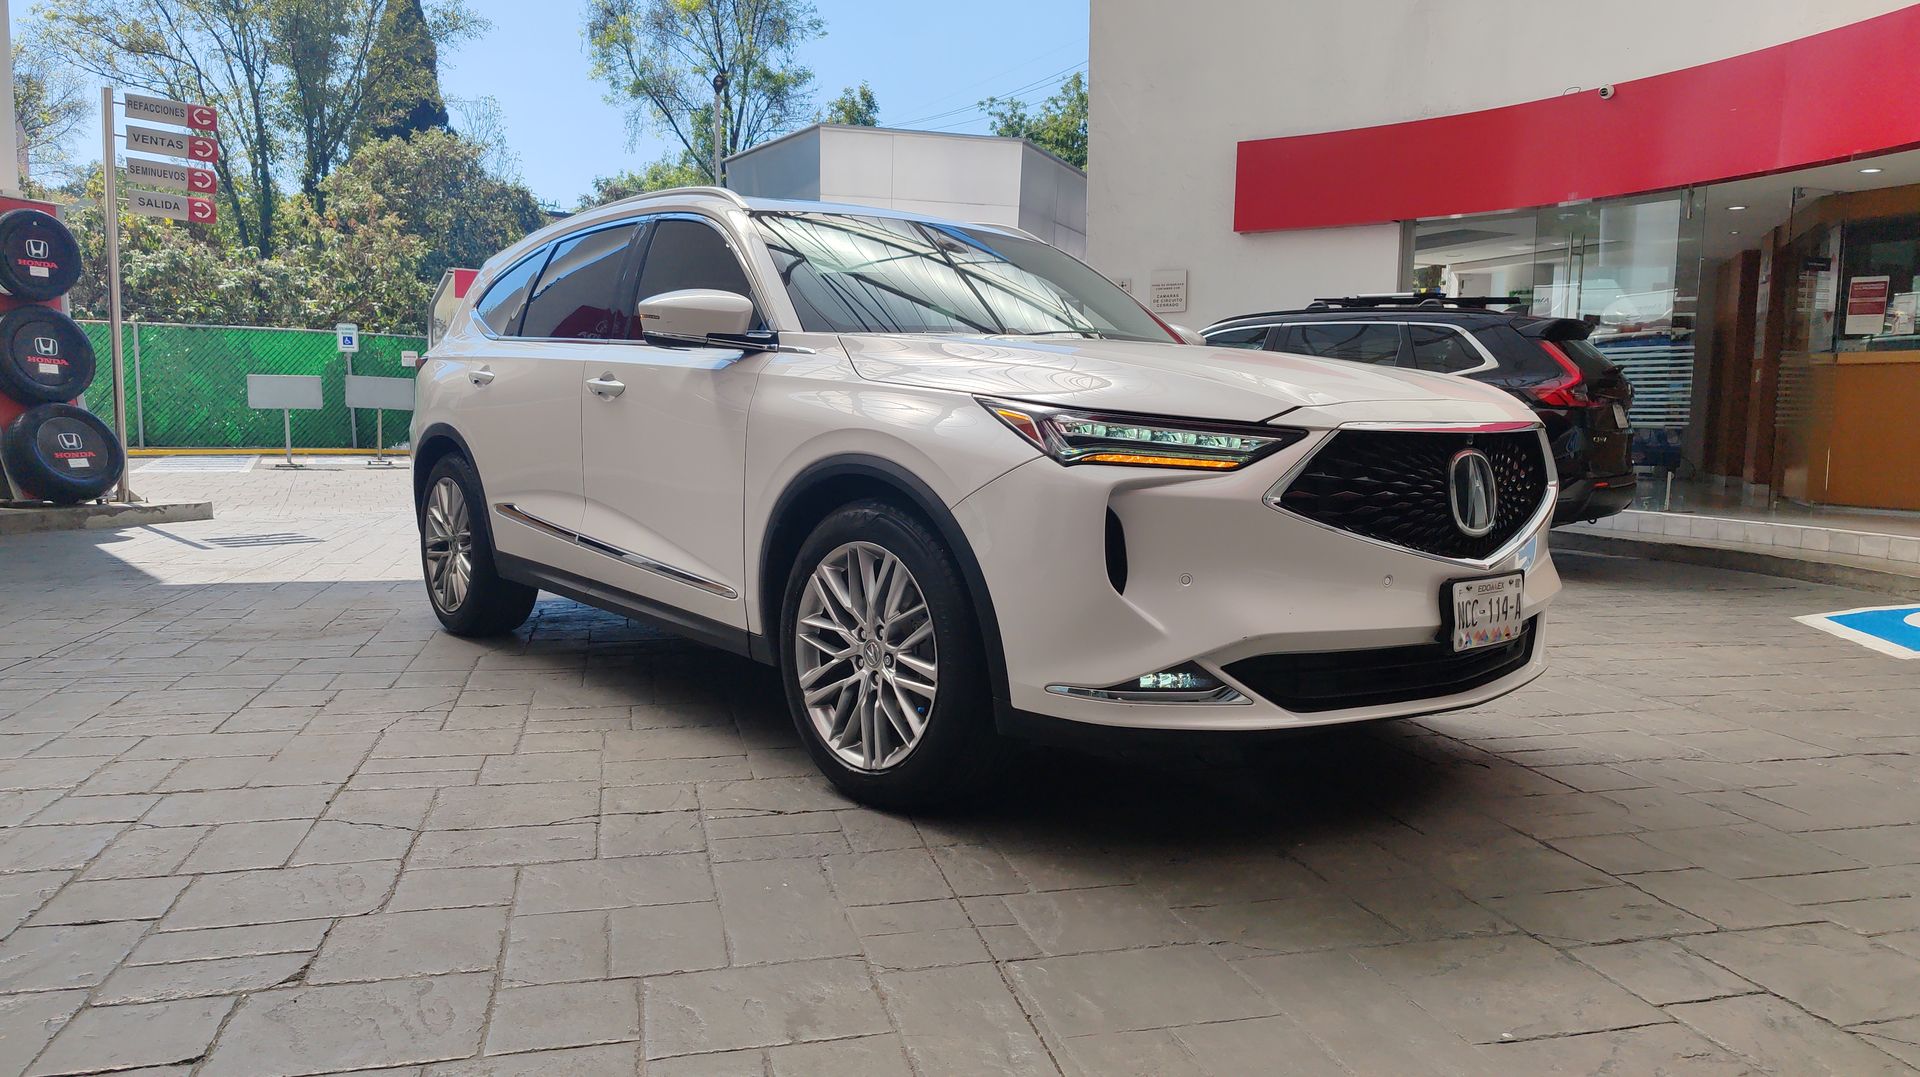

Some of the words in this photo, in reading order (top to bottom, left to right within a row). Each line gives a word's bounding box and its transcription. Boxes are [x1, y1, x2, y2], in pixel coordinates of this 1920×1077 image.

[127, 100, 185, 118] REFACCIONES
[132, 132, 184, 149] VENTAS
[129, 164, 186, 181] SEMINUEVOS
[138, 197, 181, 211] SALIDA
[17, 258, 58, 268] HONDA
[26, 355, 69, 366] HONDA
